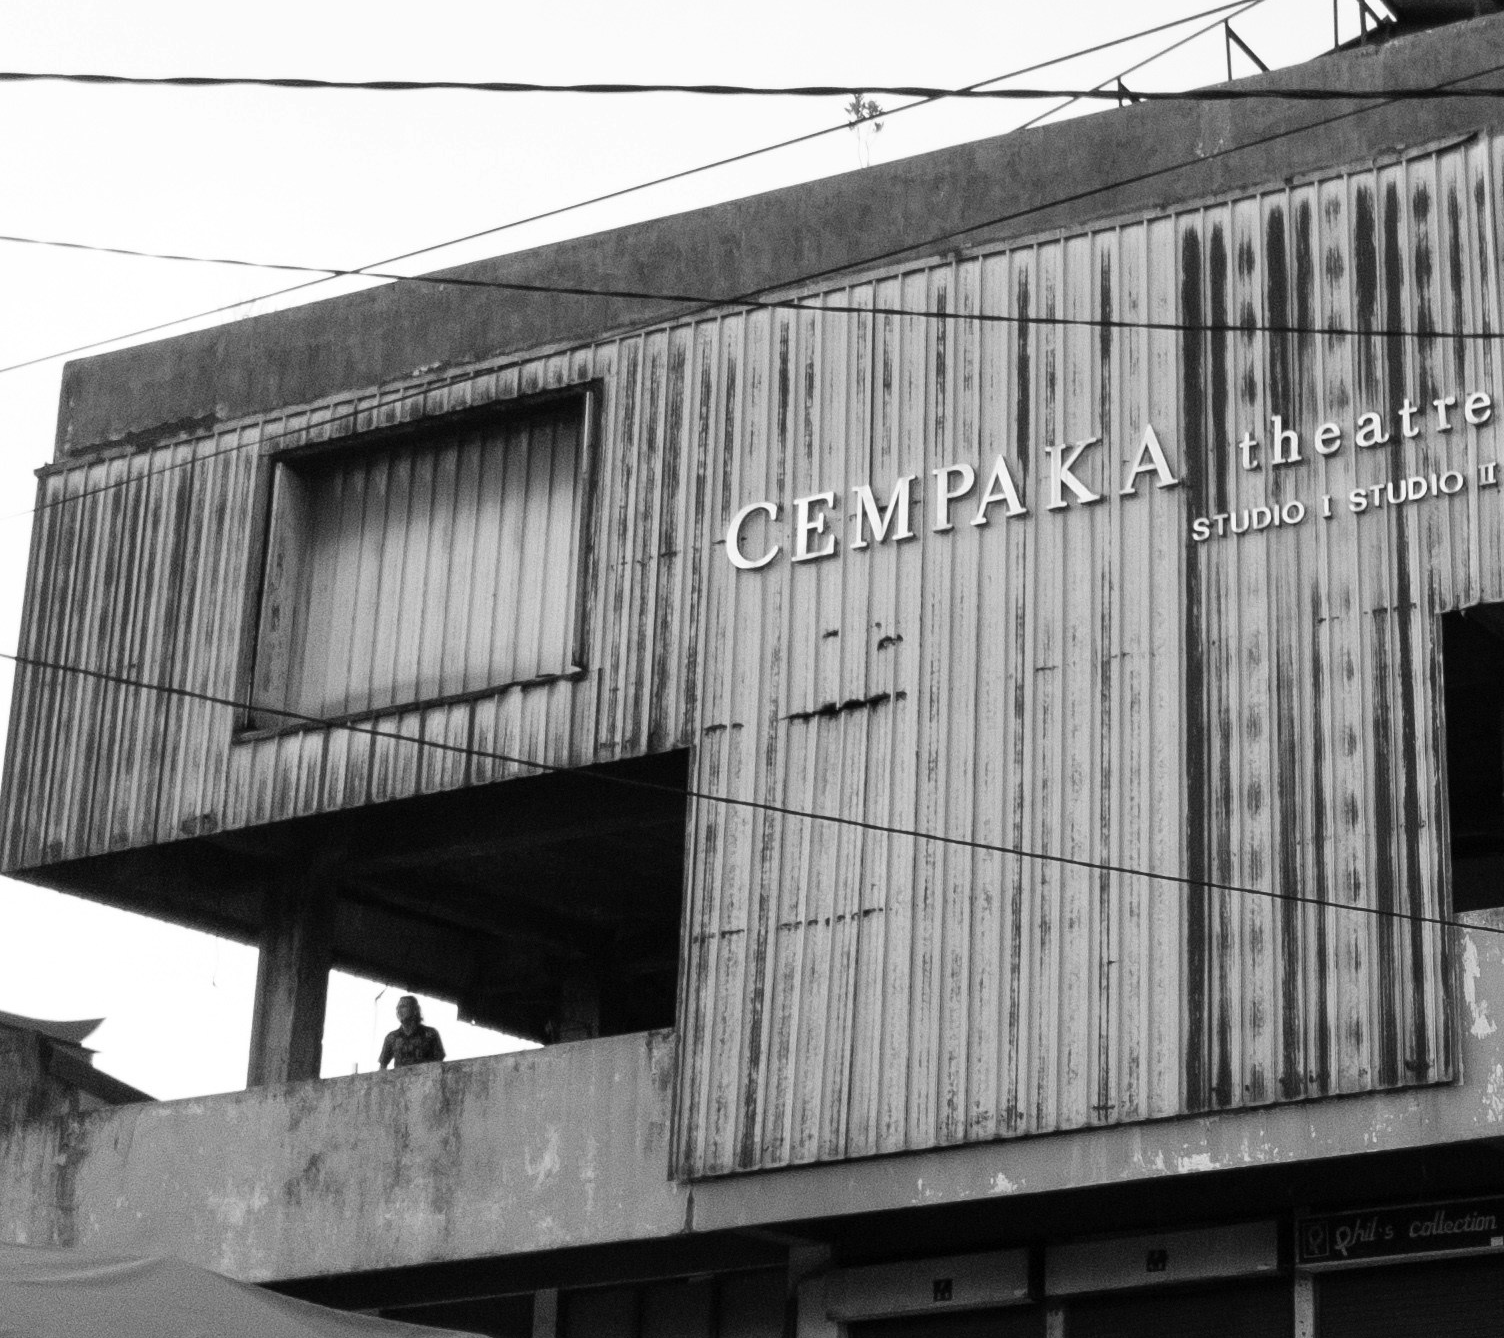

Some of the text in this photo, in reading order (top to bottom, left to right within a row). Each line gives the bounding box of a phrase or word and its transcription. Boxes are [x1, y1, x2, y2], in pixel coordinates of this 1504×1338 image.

[726, 391, 1491, 569] CEMPAKA theatre
[1191, 461, 1498, 541] STUDIO I STUDIO II
[1409, 1210, 1496, 1238] collection
